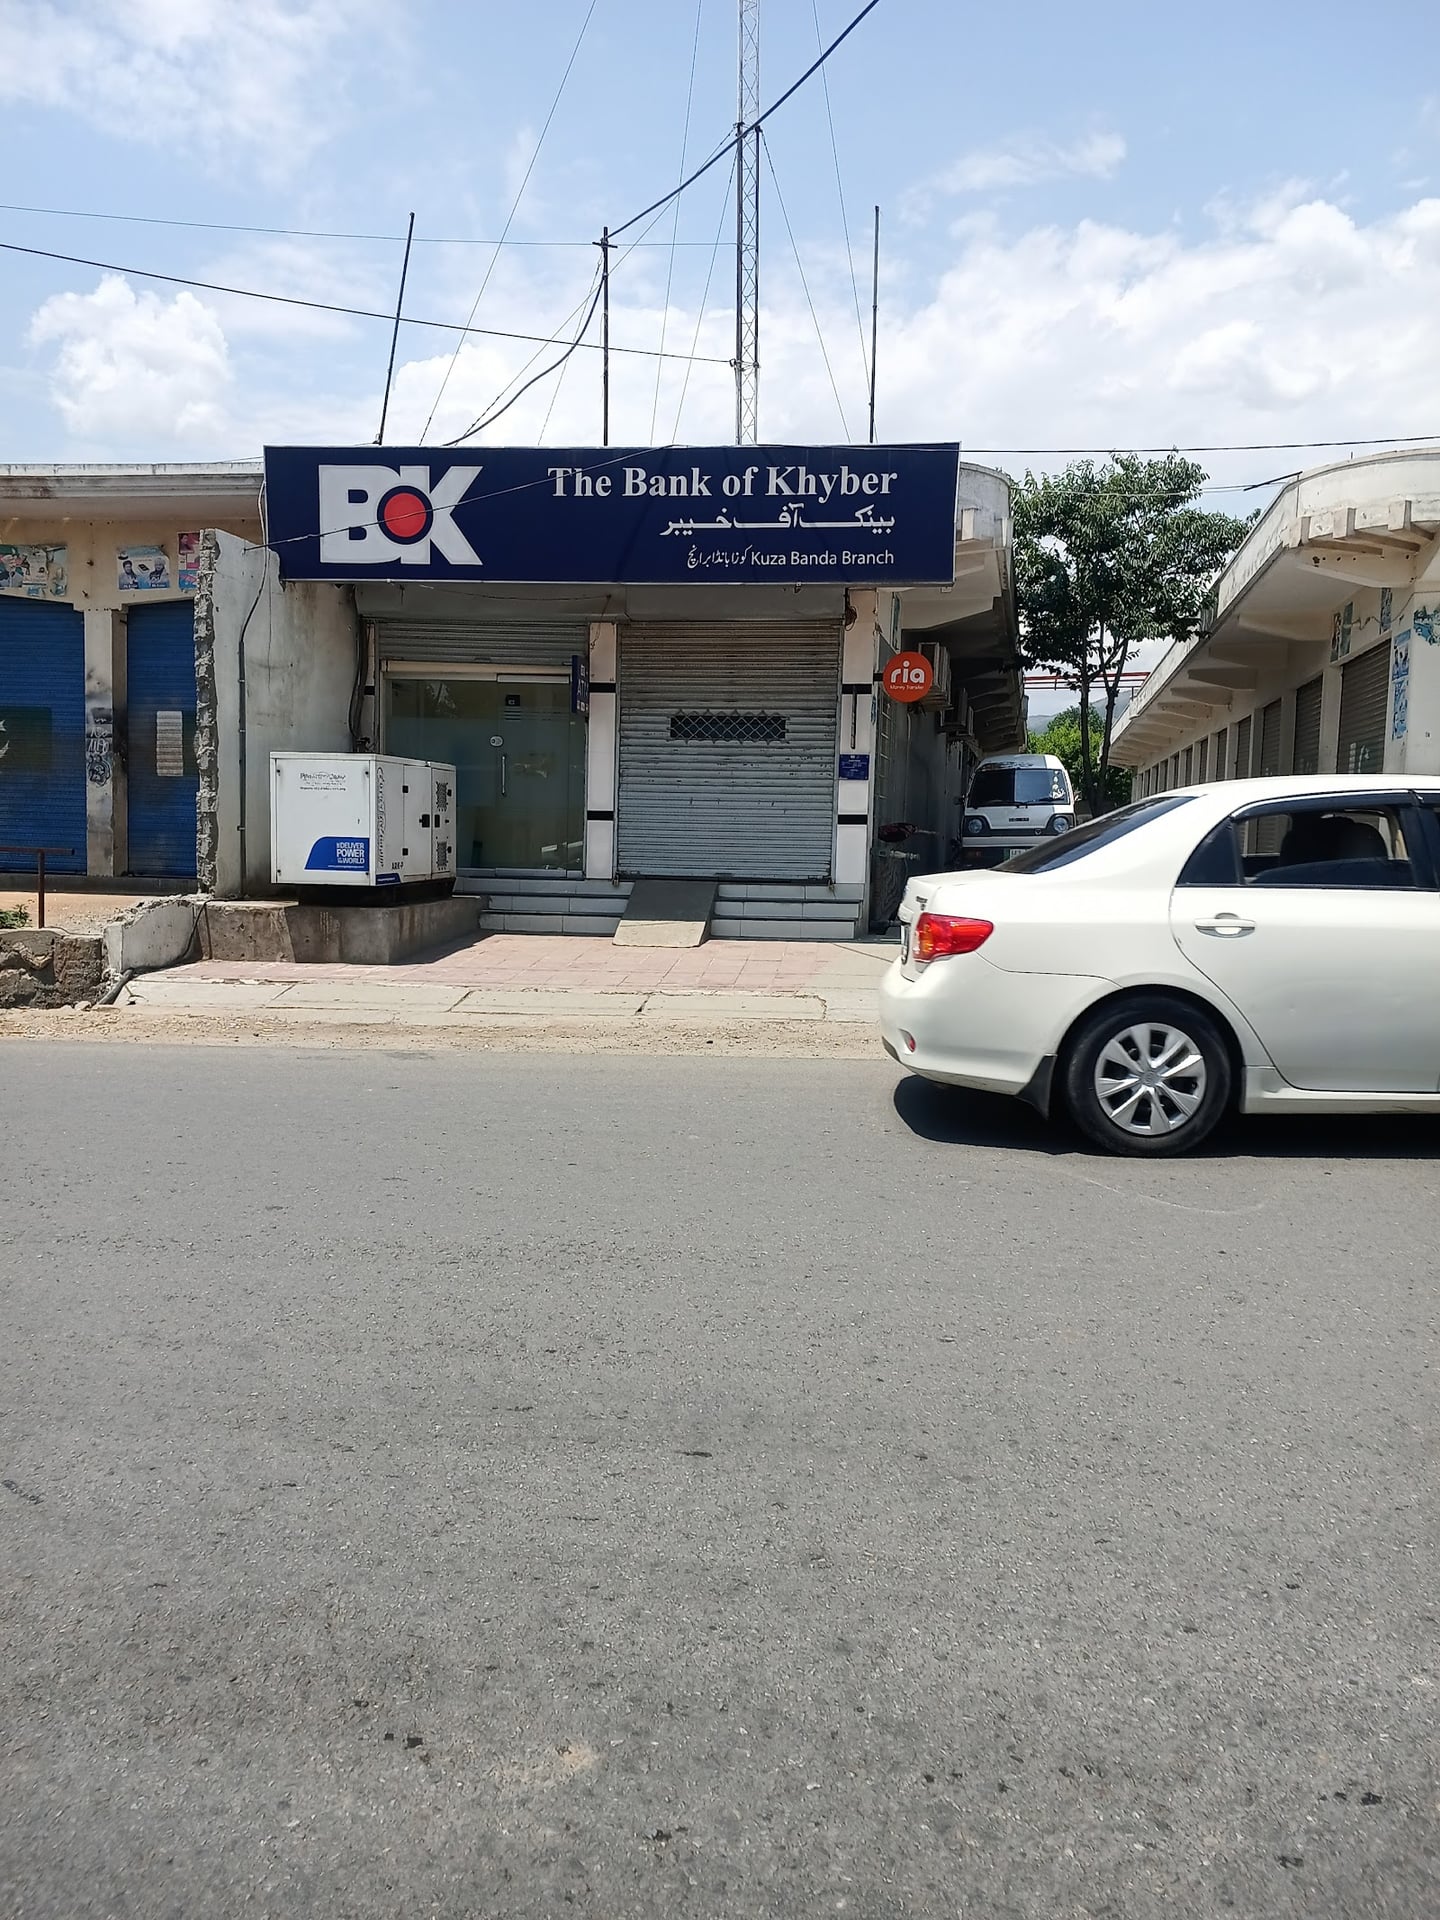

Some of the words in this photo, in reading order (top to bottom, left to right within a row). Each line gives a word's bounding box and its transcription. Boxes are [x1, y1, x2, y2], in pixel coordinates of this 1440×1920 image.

[548, 467, 612, 497] The
[622, 467, 712, 497] Bank
[722, 466, 758, 497] of
[765, 466, 898, 503] Khyber
[318, 464, 483, 566] BOK
[659, 507, 732, 536] خیبر
[751, 551, 786, 566] Kuza
[790, 550, 837, 566] Banda
[842, 549, 894, 565] Branch
[890, 660, 925, 683] ria
[336, 849, 365, 858] POWER
